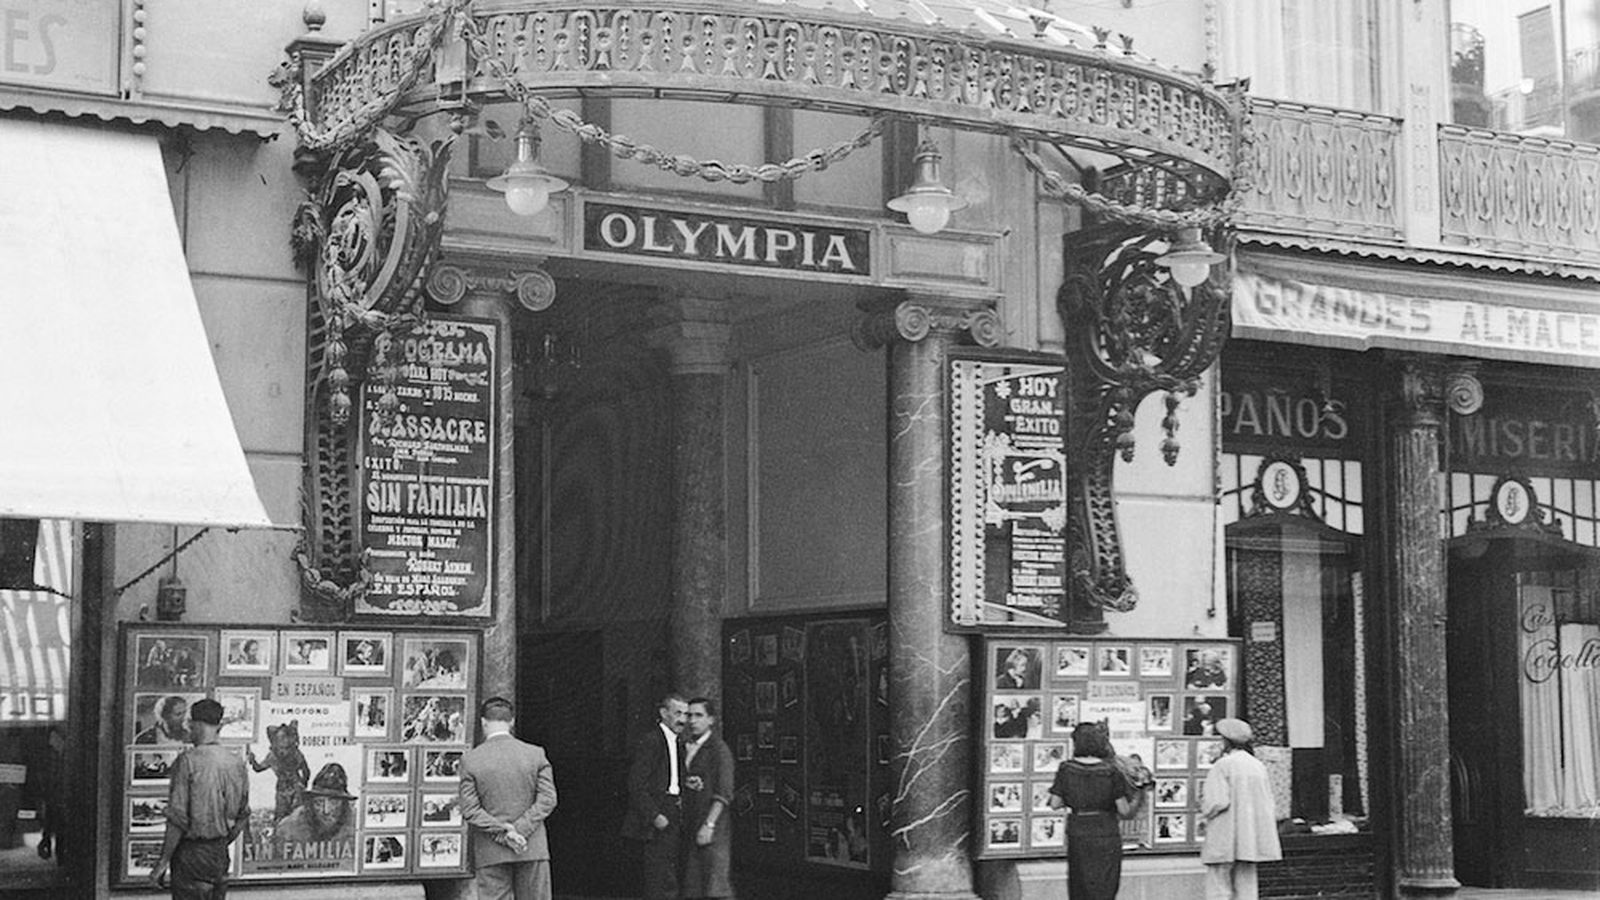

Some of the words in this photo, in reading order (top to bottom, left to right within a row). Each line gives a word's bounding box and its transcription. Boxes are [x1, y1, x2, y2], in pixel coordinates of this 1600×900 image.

[600, 212, 856, 271] OLYMPIA
[1255, 278, 1431, 334] GRANDES
[1018, 376, 1058, 398] HOY
[1015, 415, 1060, 435] EXITO
[1219, 387, 1348, 440] PAÑOS
[366, 481, 401, 513] SIN
[407, 483, 486, 518] FAMILIA
[277, 683, 290, 697] EN
[294, 682, 337, 698] ESPAÑOL
[244, 843, 274, 861] SIN
[284, 841, 354, 860] FAMILIA
